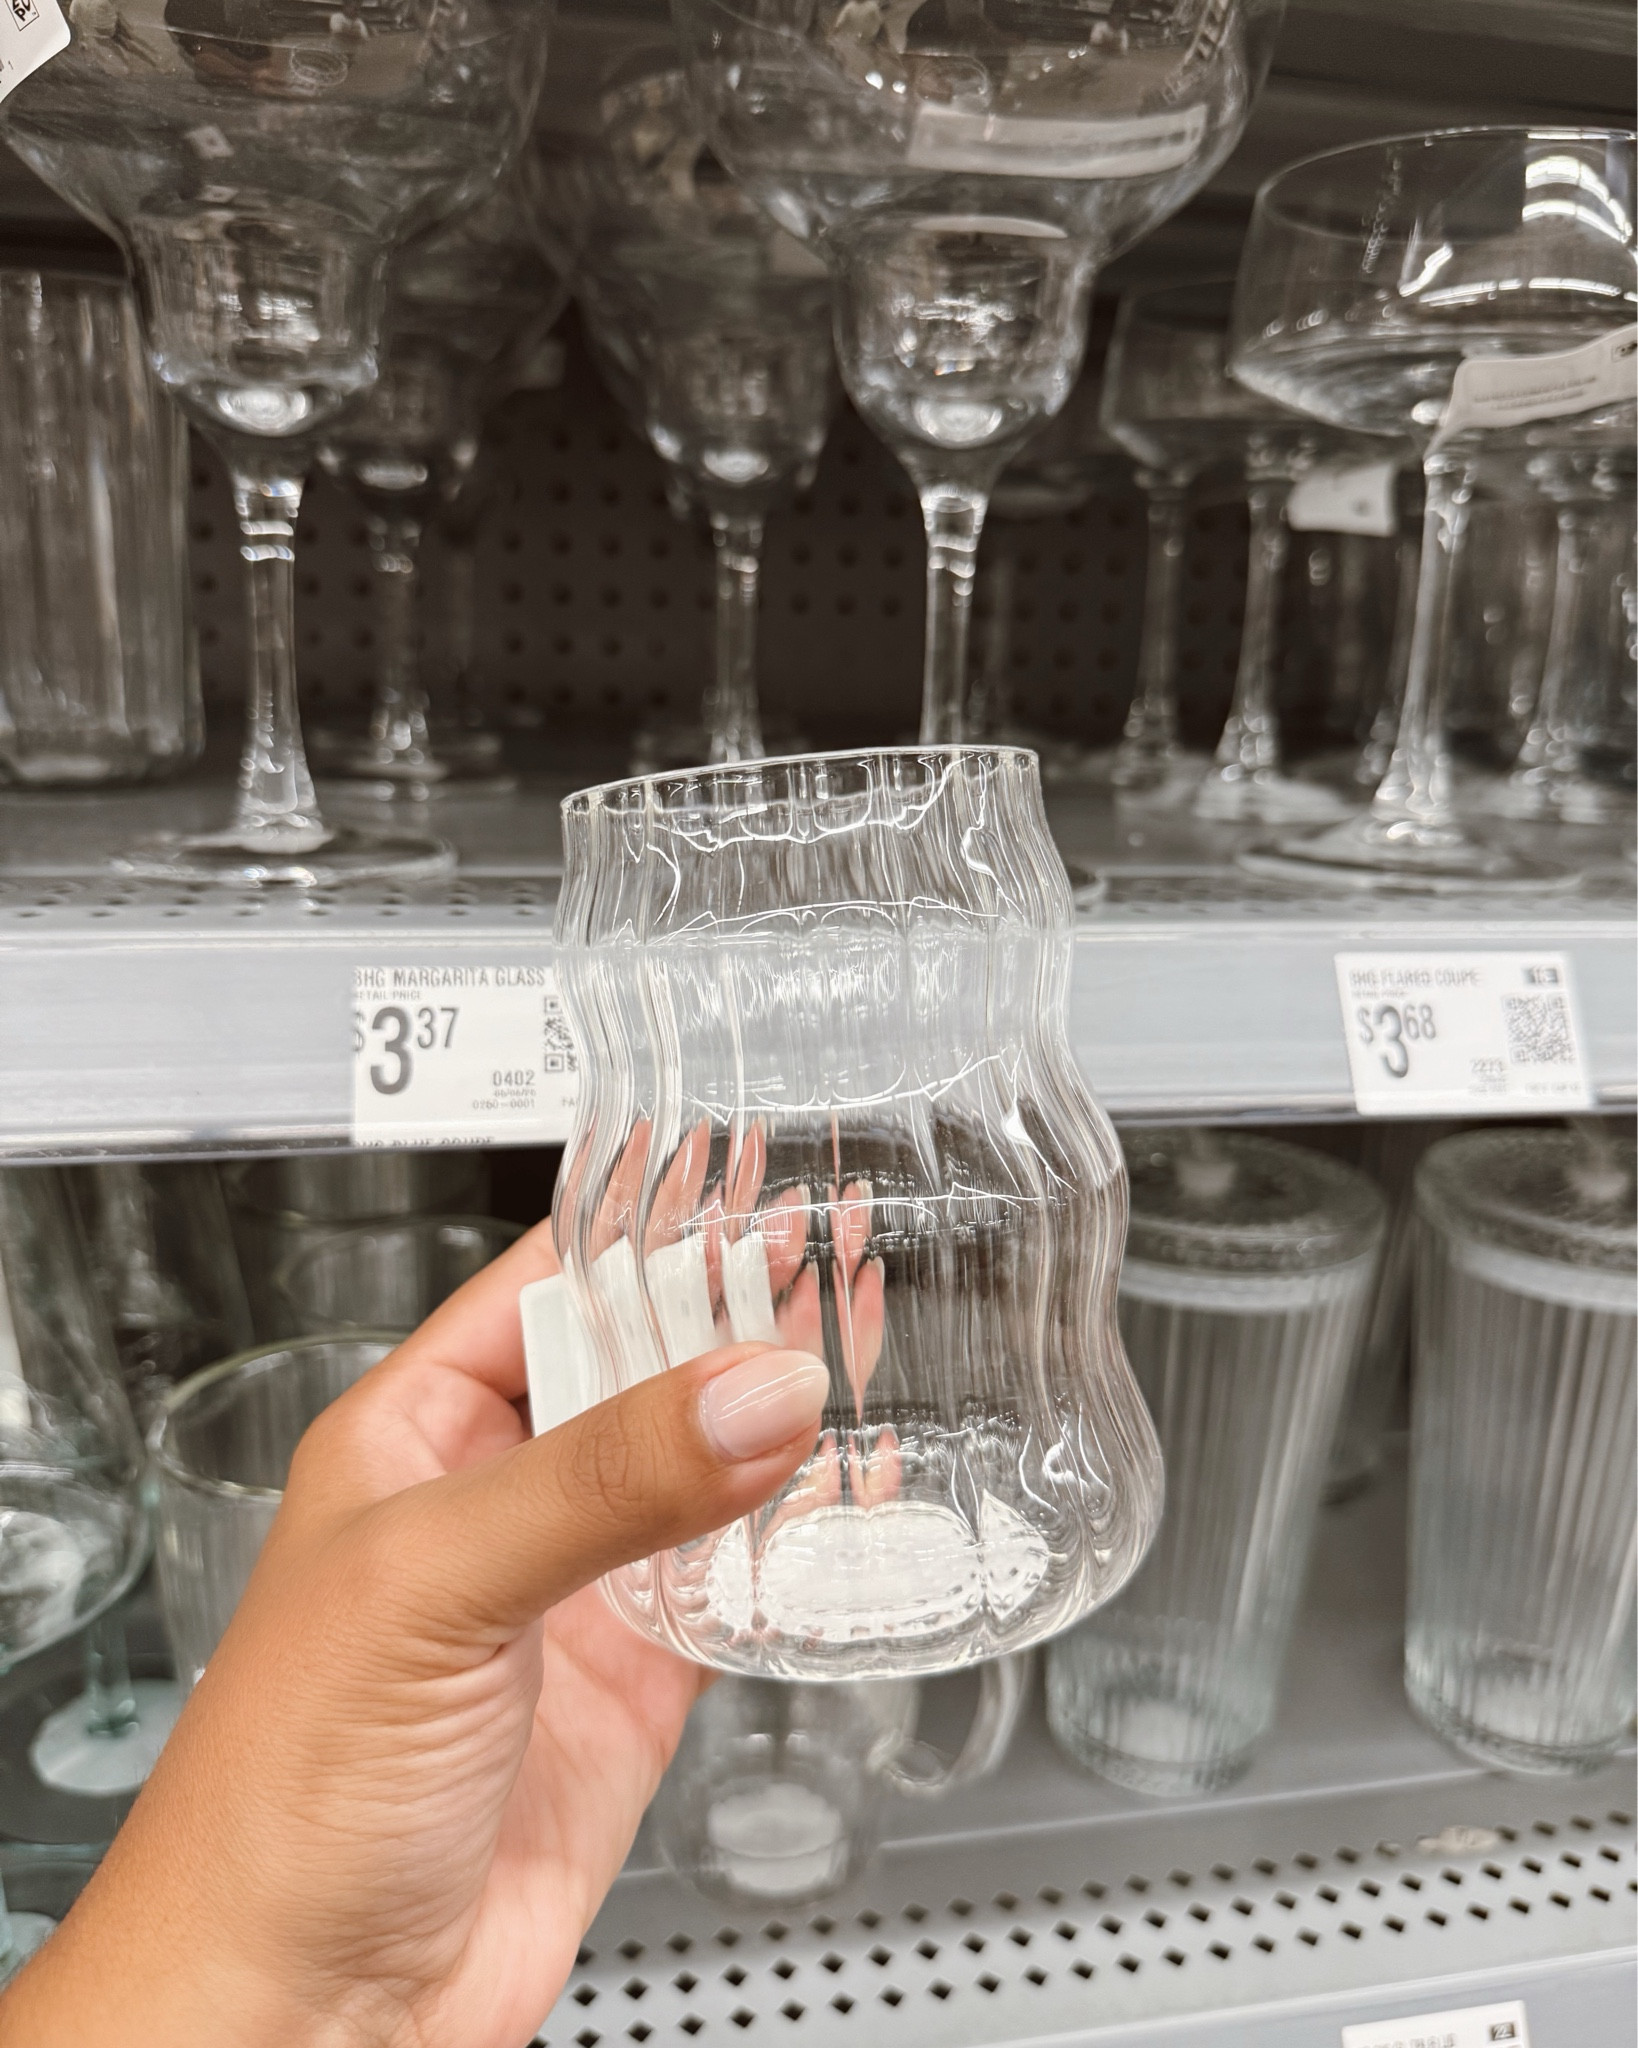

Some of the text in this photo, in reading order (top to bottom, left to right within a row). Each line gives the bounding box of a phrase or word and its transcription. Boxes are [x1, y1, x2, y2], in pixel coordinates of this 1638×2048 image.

[393, 967, 489, 988] MARGARITA
[495, 967, 546, 988] GLASS
[492, 1070, 536, 1087] 0402
